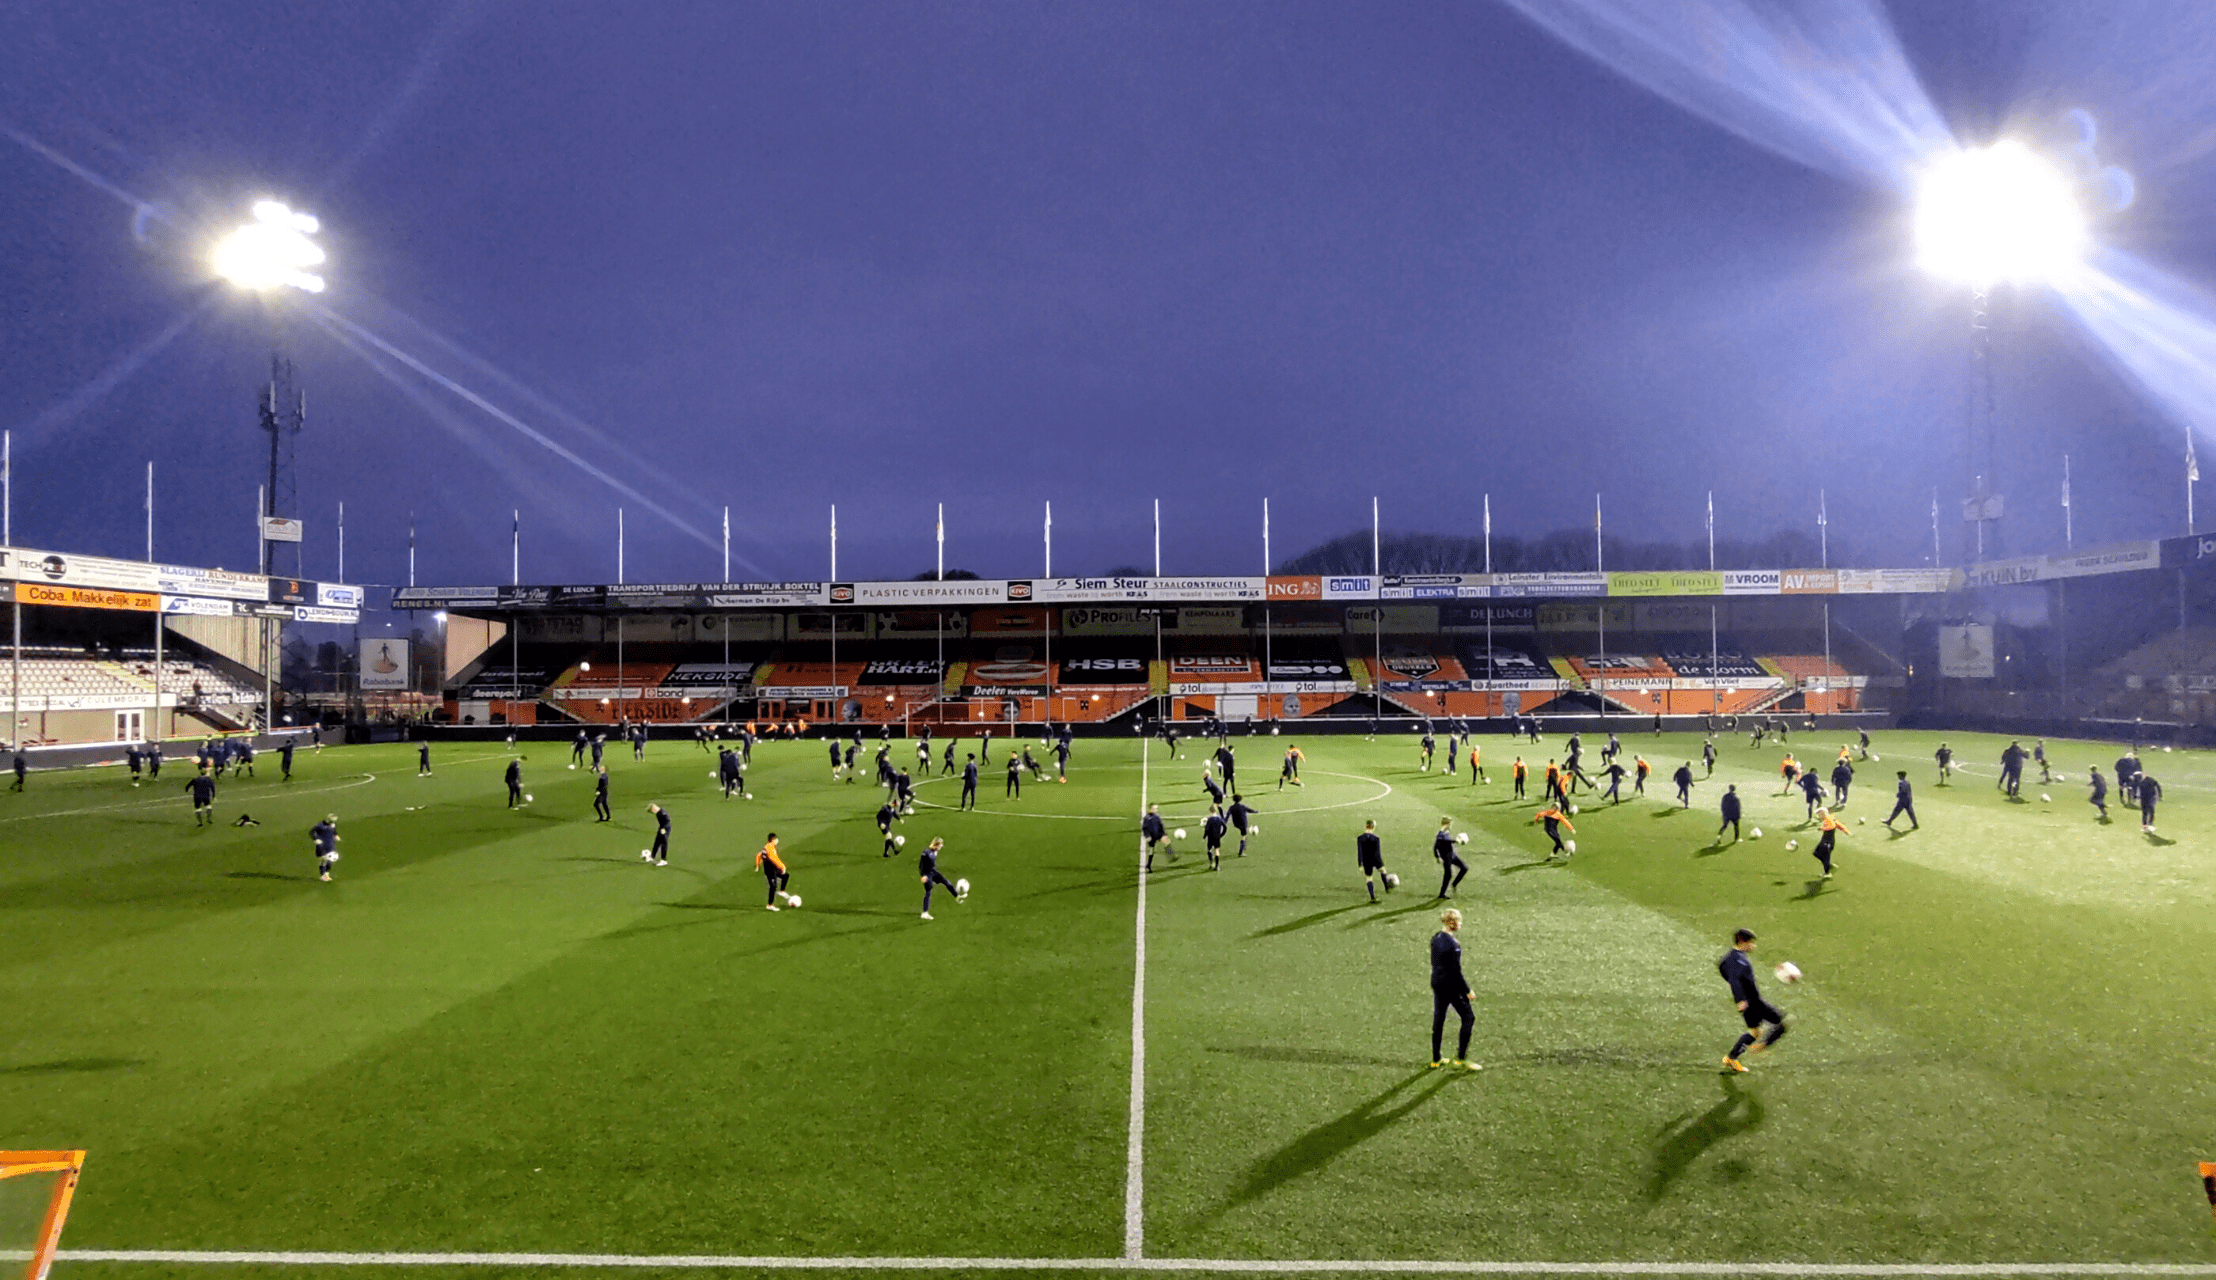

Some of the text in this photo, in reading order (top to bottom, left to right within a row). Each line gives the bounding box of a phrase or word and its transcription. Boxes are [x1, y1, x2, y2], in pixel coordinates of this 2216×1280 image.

[207, 570, 269, 584] RUNDERKAMP
[1735, 574, 1779, 584] VROOM
[1783, 574, 1804, 590] AV
[784, 582, 820, 590] BOXTEL
[1075, 578, 1148, 589] Siem Steur
[1330, 579, 1370, 591] smit
[834, 589, 851, 597] KIVO
[914, 587, 1000, 596] VERPAKKINGEN
[1011, 586, 1029, 595] KIVO
[1267, 583, 1299, 595] ING
[1381, 587, 1414, 598] smit
[1416, 588, 1455, 597] ELEKTRA
[1457, 586, 1491, 597] smit
[29, 587, 67, 602] Coba.
[135, 597, 151, 607] zat
[191, 602, 228, 610] VOLENDAM
[1347, 611, 1370, 620] Care
[1068, 659, 1141, 670] HSB
[1178, 657, 1242, 665] DEEN
[1678, 665, 1699, 674] de
[667, 672, 748, 681] HEKSIDE
[973, 686, 1006, 696] Deelen
[1188, 683, 1201, 692] tol
[1303, 682, 1316, 691] tol
[658, 688, 684, 698] bond
[86, 695, 148, 705] CULEMBORG
